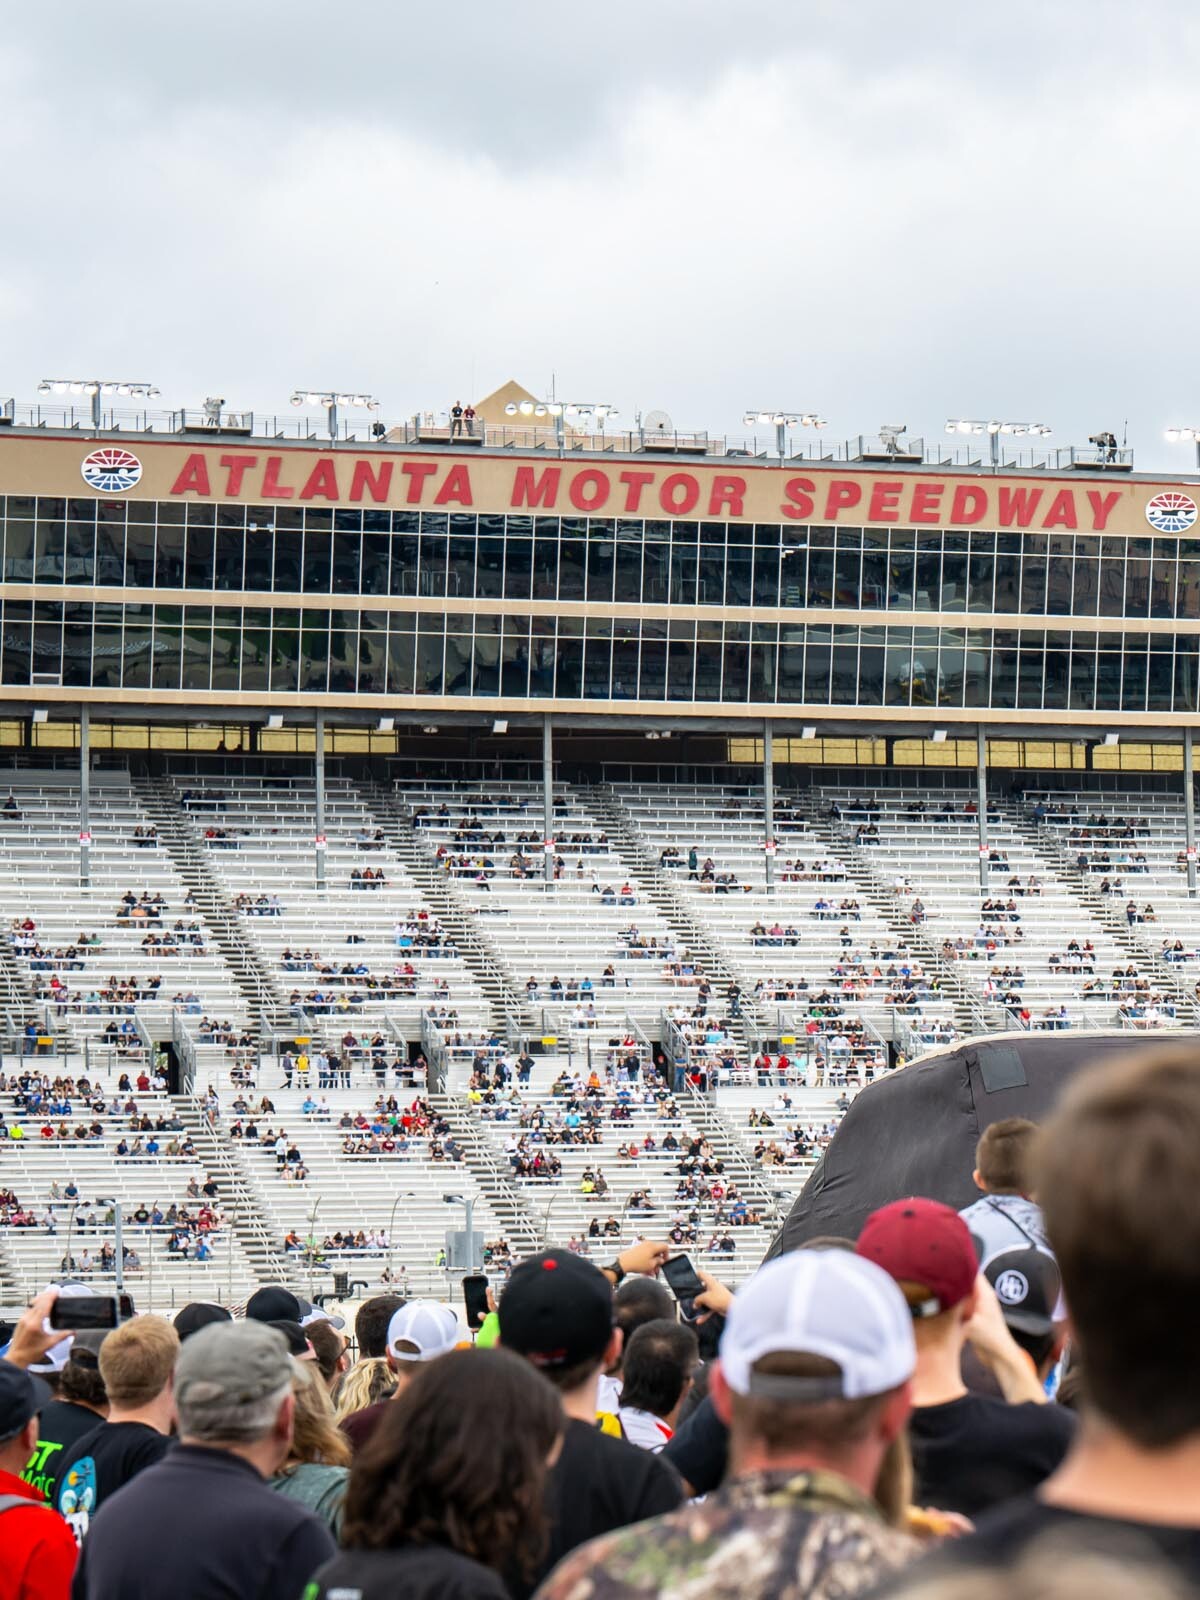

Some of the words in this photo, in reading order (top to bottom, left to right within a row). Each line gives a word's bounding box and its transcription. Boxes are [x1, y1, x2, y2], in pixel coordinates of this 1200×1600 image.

[171, 454, 472, 506] ATLANTA
[511, 466, 746, 517] MOTOR
[782, 477, 1120, 530] SPEEDWAY
